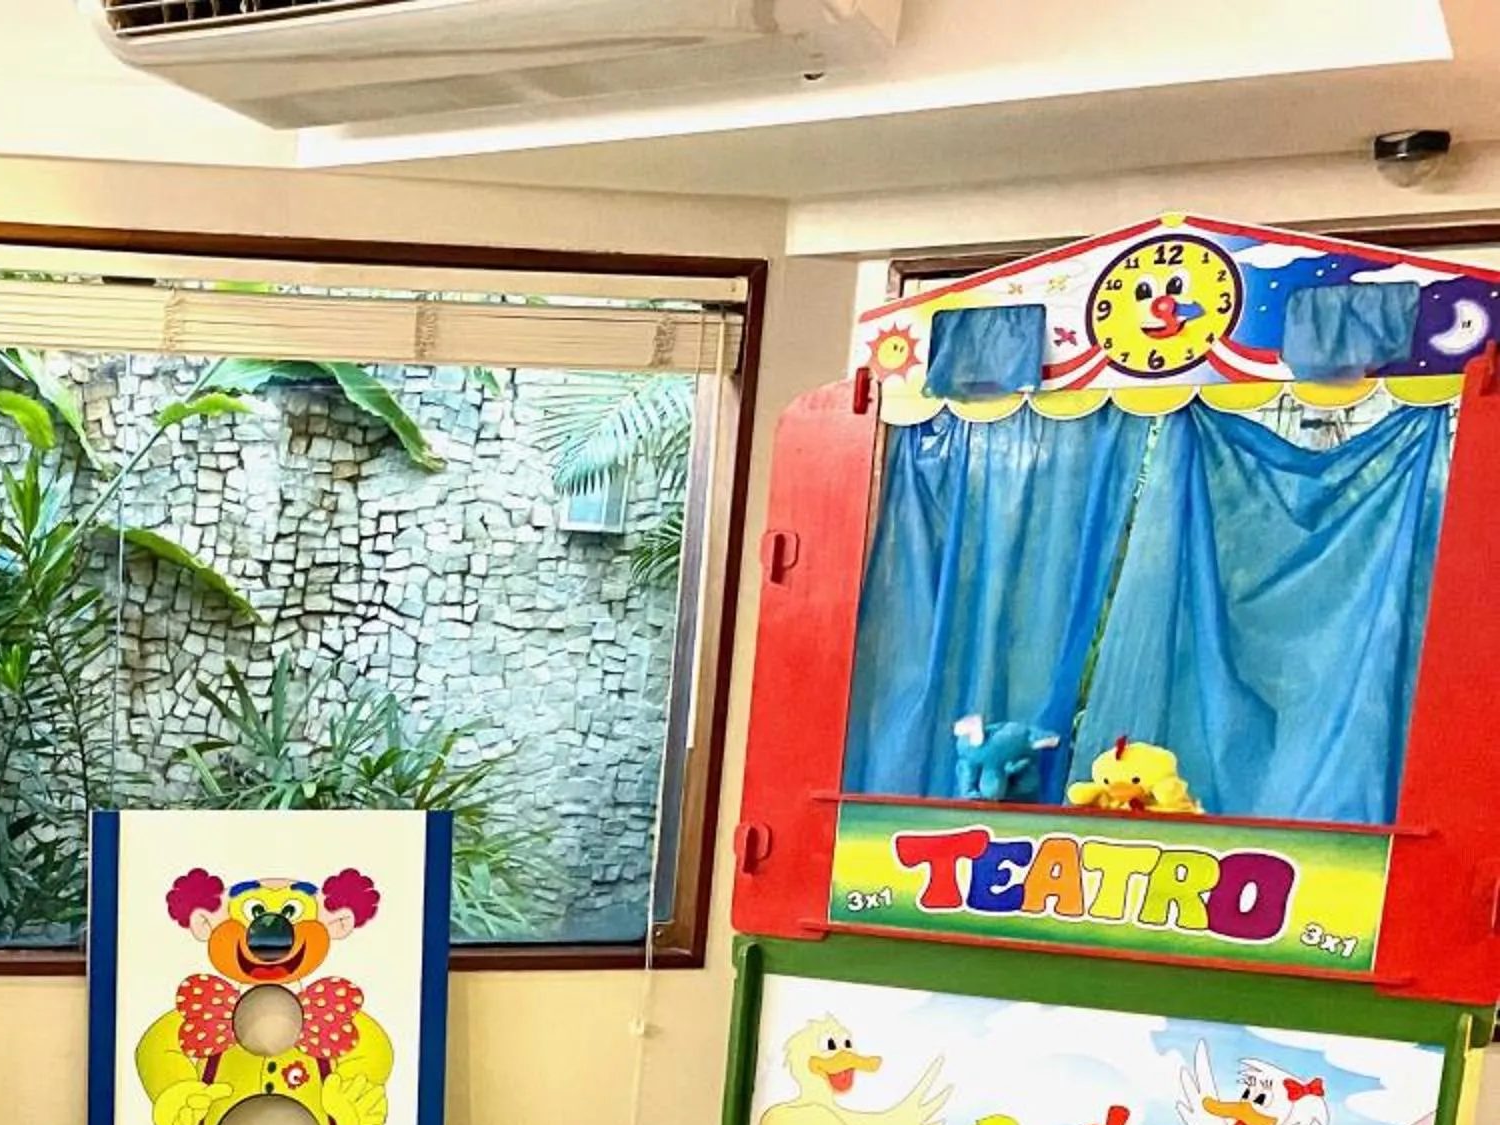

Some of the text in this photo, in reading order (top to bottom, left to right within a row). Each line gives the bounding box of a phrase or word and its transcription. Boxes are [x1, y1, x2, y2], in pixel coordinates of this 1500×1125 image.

[1153, 243, 1185, 265] 12
[1201, 252, 1211, 265] 1
[1124, 257, 1140, 269] 11
[1104, 278, 1123, 290] 10
[1216, 269, 1227, 282] 2
[1096, 300, 1112, 322] 9
[1216, 292, 1232, 314] 3
[1103, 337, 1113, 349] 8
[1205, 332, 1215, 344] 4
[1119, 351, 1130, 363] 7
[1147, 349, 1165, 370] 6
[893, 826, 1298, 943] TEATRO
[846, 887, 893, 912] 3x1
[1300, 922, 1358, 958] 3x1
